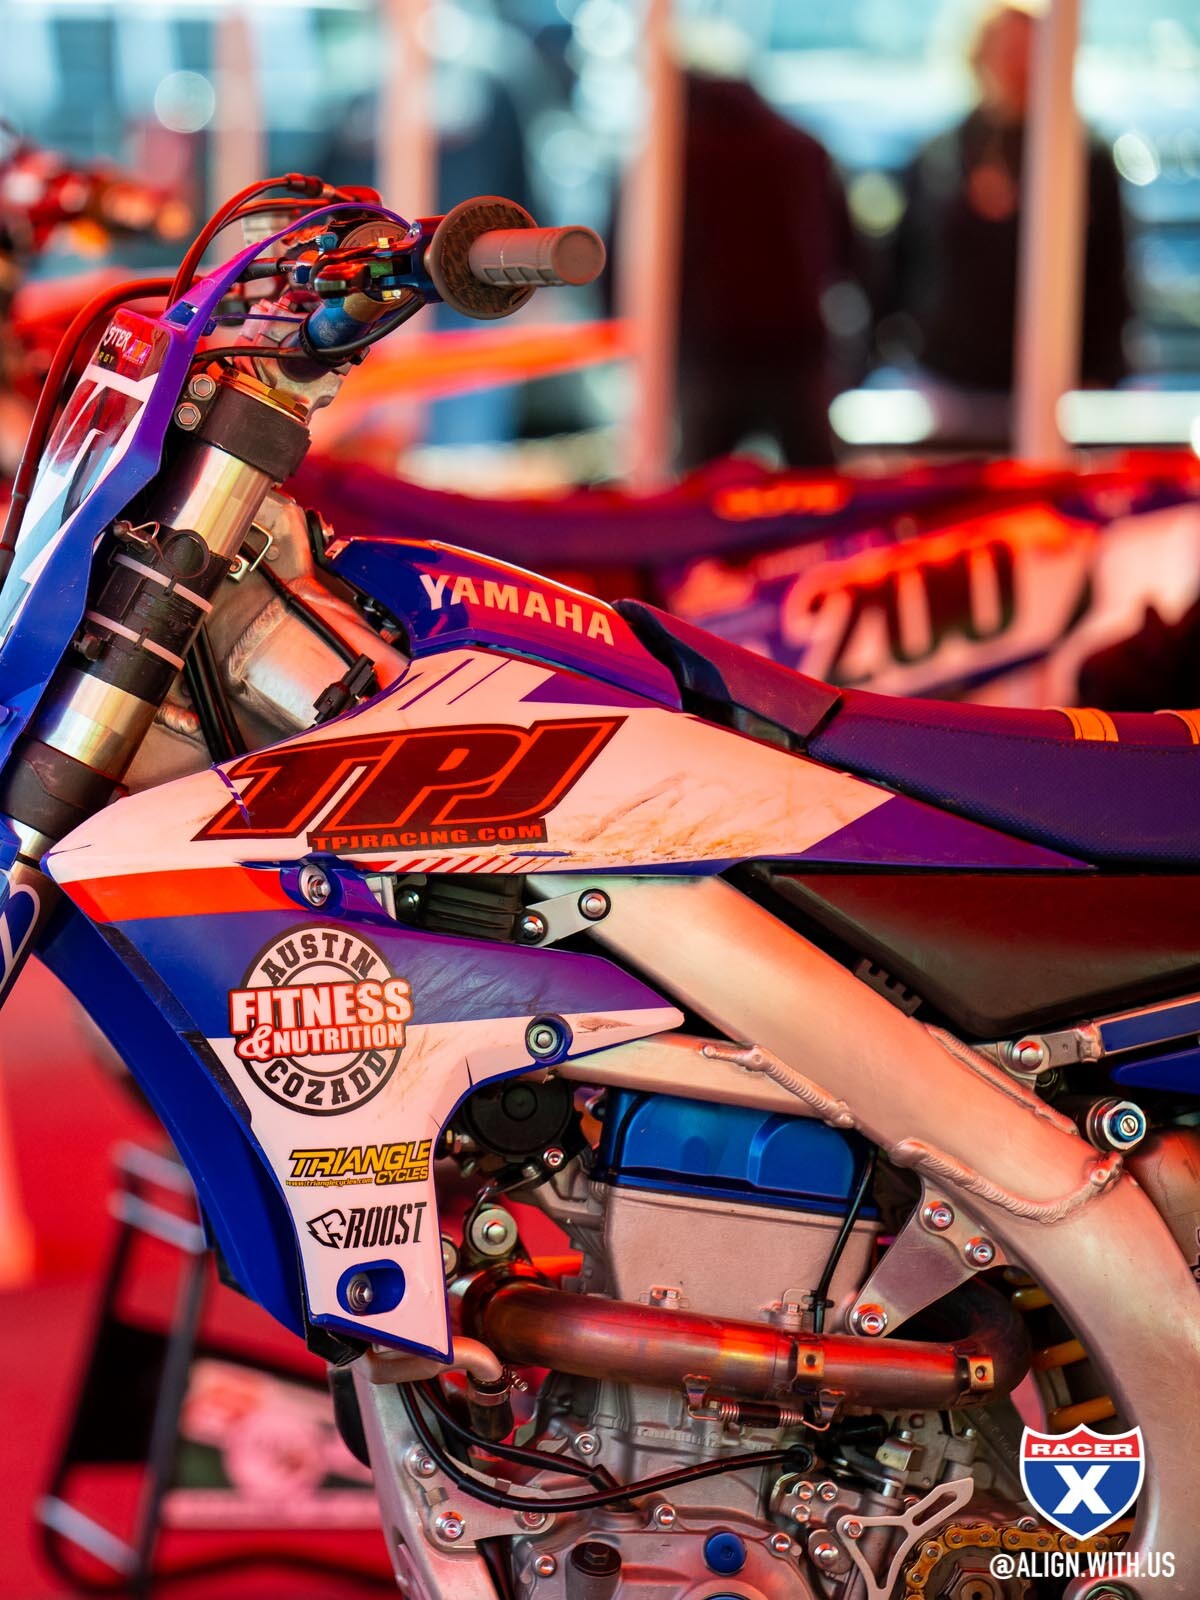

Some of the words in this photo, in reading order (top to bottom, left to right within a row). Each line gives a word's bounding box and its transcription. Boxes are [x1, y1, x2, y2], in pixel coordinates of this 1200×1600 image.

[102, 322, 133, 353] STER
[419, 574, 614, 646] YAMAHA
[191, 716, 629, 841] TPJ
[312, 824, 542, 852] TPJRACING.COM
[261, 932, 377, 986] AUSTIN
[230, 980, 413, 1034] FITNESS
[264, 1052, 387, 1106] COZADD
[289, 1140, 432, 1178] TRIANGLE
[375, 1167, 429, 1185] CYCLES
[343, 1202, 427, 1249] ROOST
